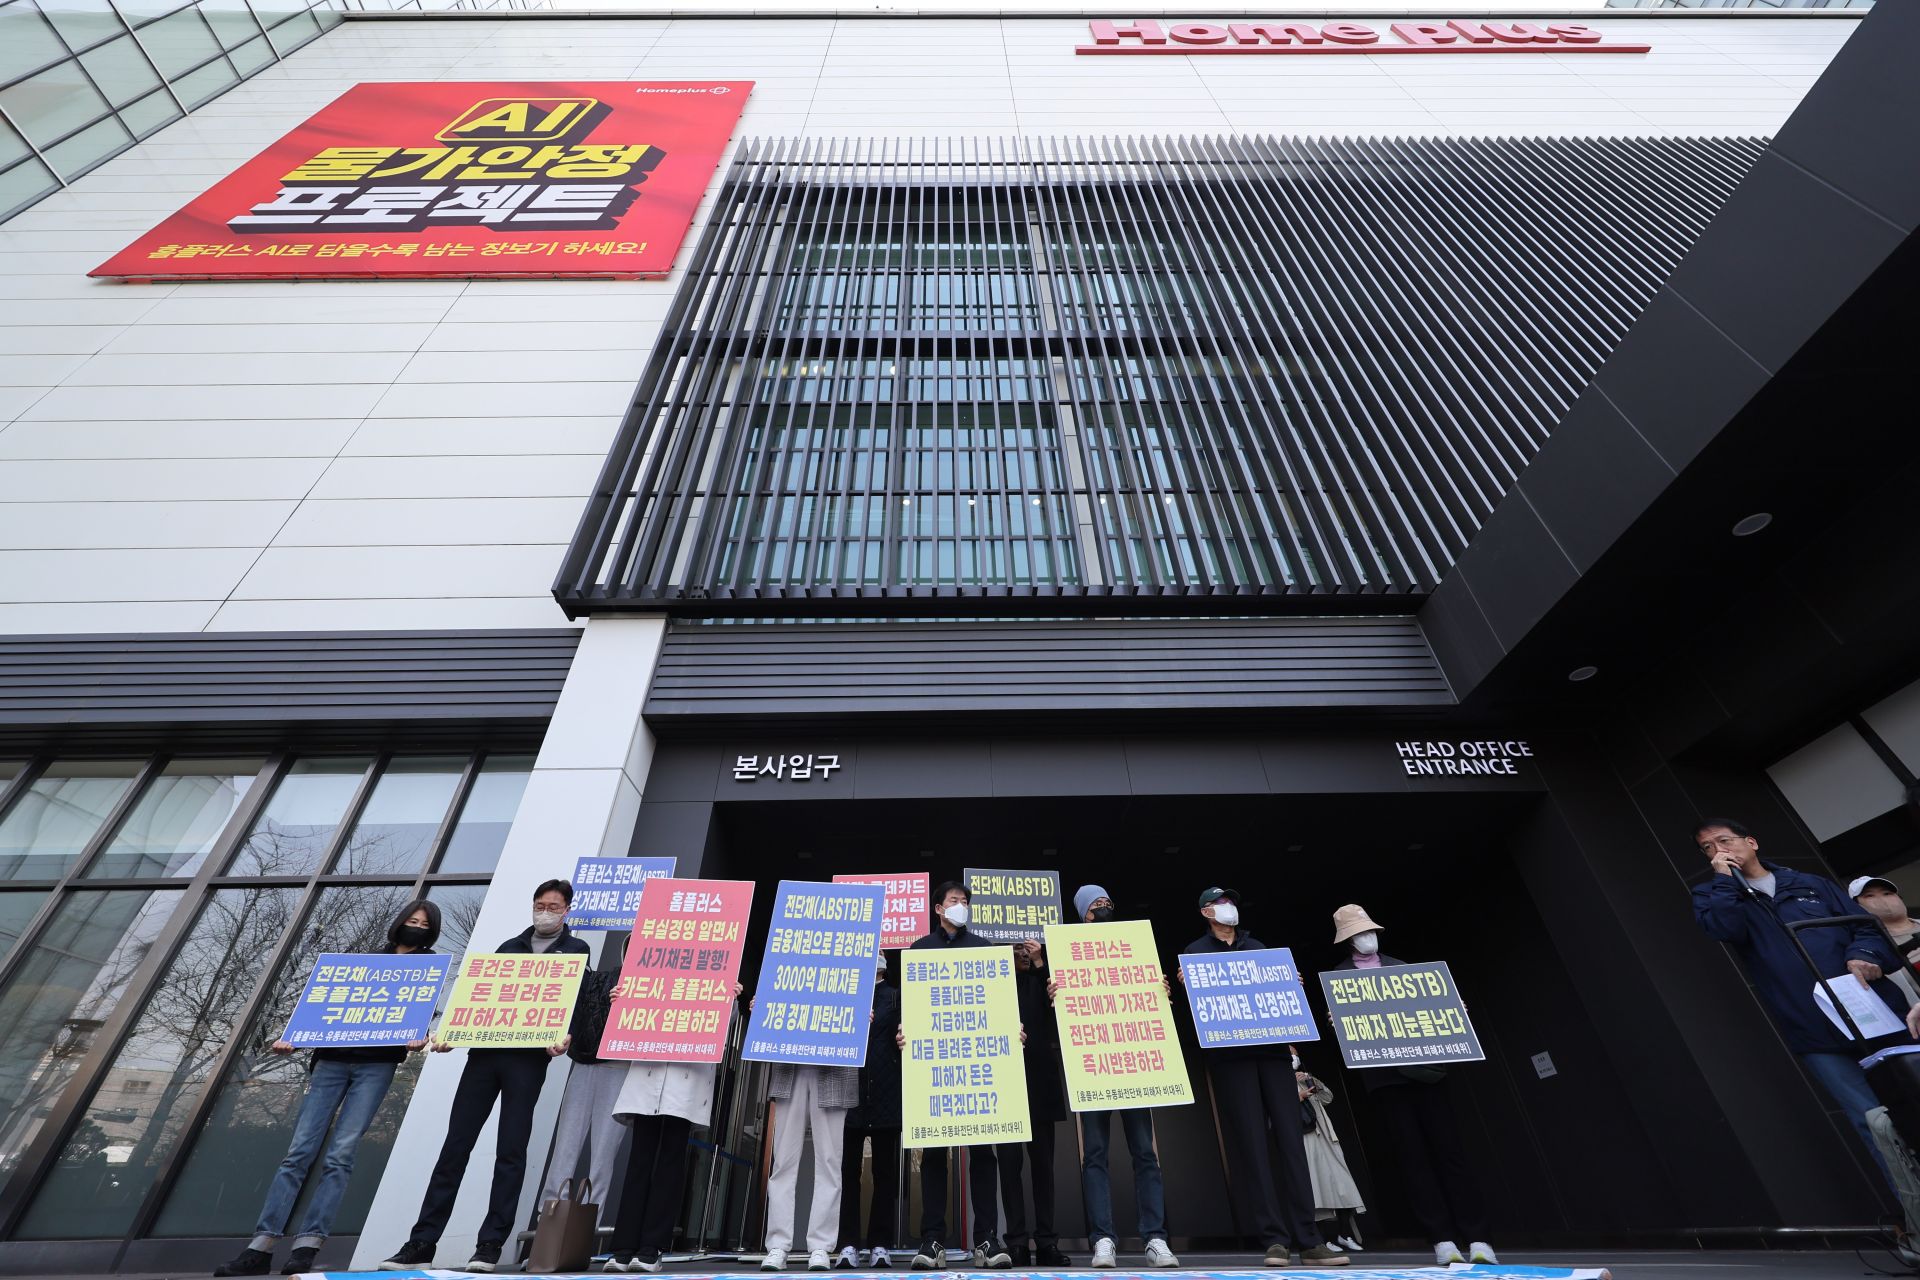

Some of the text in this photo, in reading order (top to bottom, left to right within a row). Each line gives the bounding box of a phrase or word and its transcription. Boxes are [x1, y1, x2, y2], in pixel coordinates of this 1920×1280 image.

[1089, 19, 1602, 45] Home plus
[452, 102, 580, 132] AI
[280, 144, 649, 181] 물가안정
[225, 184, 625, 224] 프로젝트
[147, 242, 647, 259] 홈플러스 AI로 담을수록 남는 장보기 하세요!
[1396, 741, 1534, 757] HEAD OFFICE
[733, 754, 840, 779] 본사입구
[1403, 759, 1518, 774] ENTRANCE
[577, 864, 612, 884] 홈플러스
[885, 880, 925, 894] 데카드
[971, 876, 1054, 896] 전단채(ABSTB)
[570, 891, 643, 912] 상거래채권, 인정
[669, 891, 722, 912] 홈플러스
[784, 894, 874, 923] 전단채(ABSTB)를
[885, 898, 924, 913] 채권
[971, 904, 1058, 925] 피해자 피눈물난다
[641, 919, 739, 942] 부실경영 알면서
[1025, 931, 1039, 939] 피해자
[771, 928, 875, 958] 금융채권으로 결정하면
[1070, 940, 1133, 961] 홈플러스는
[467, 959, 580, 978] 물건은 팔아놓고
[637, 947, 729, 971] 사기채권 발행!
[907, 959, 1010, 982] 홈플러스 기업회생 후
[316, 966, 442, 983] 전단채(ABSTB)는
[774, 965, 860, 995] 3000억 피해자들
[1054, 964, 1159, 989] 물건값 지불하려고
[1187, 960, 1293, 989] 홈플러스 전단채(ABSTB)
[306, 986, 436, 1003] 홈플러스 위한
[470, 983, 563, 1002] 돈 빌려준
[620, 976, 730, 1003] 카드사, 홈플러스,
[930, 984, 986, 1007] 물품대금은
[1329, 970, 1448, 1004] 전단채(ABSTB)
[321, 1006, 407, 1024] 구매채권
[1065, 991, 1159, 1017] 국민에게 가져간
[1196, 990, 1303, 1023] 상거래채권, 인정하라
[449, 1007, 567, 1027] 피해자 외면
[617, 1008, 720, 1033] MBK 엄벌하라
[762, 1002, 855, 1034] 가정 경제 파탄난다.
[931, 1010, 988, 1033] 지급하면서
[1340, 1008, 1467, 1042] 피해자 피눈물난다
[290, 1029, 418, 1042] [홈플러스 유동화전단채 피해자 비대위]
[443, 1030, 558, 1042] [홈플러스 유동화전단채 피해자 비대위]
[1069, 1019, 1166, 1046] 전단채 피해대금
[1205, 1024, 1309, 1043] [홈플러스 유동화전단채 피해자 비대위]
[607, 1039, 716, 1055] [홈플러스 유동화전단채 피해자 비대위]
[751, 1040, 858, 1059] [홈플러스 유동화전단채 피해자 비대위]
[911, 1035, 1010, 1061] 대금 빌려준 전단채
[1350, 1042, 1472, 1061] [홈플러스 유동화전단채 피해자 비대위]
[1082, 1049, 1165, 1076] 즉시반환하라
[931, 1063, 993, 1088] 피해자 돈은
[929, 1092, 998, 1117] 떼먹겠다고?
[1077, 1083, 1184, 1103] [홈플러스 유동화전단채 피해자 비대위]
[911, 1121, 1023, 1140] [홈플러스 유동화전단채 피해자 비대위]
